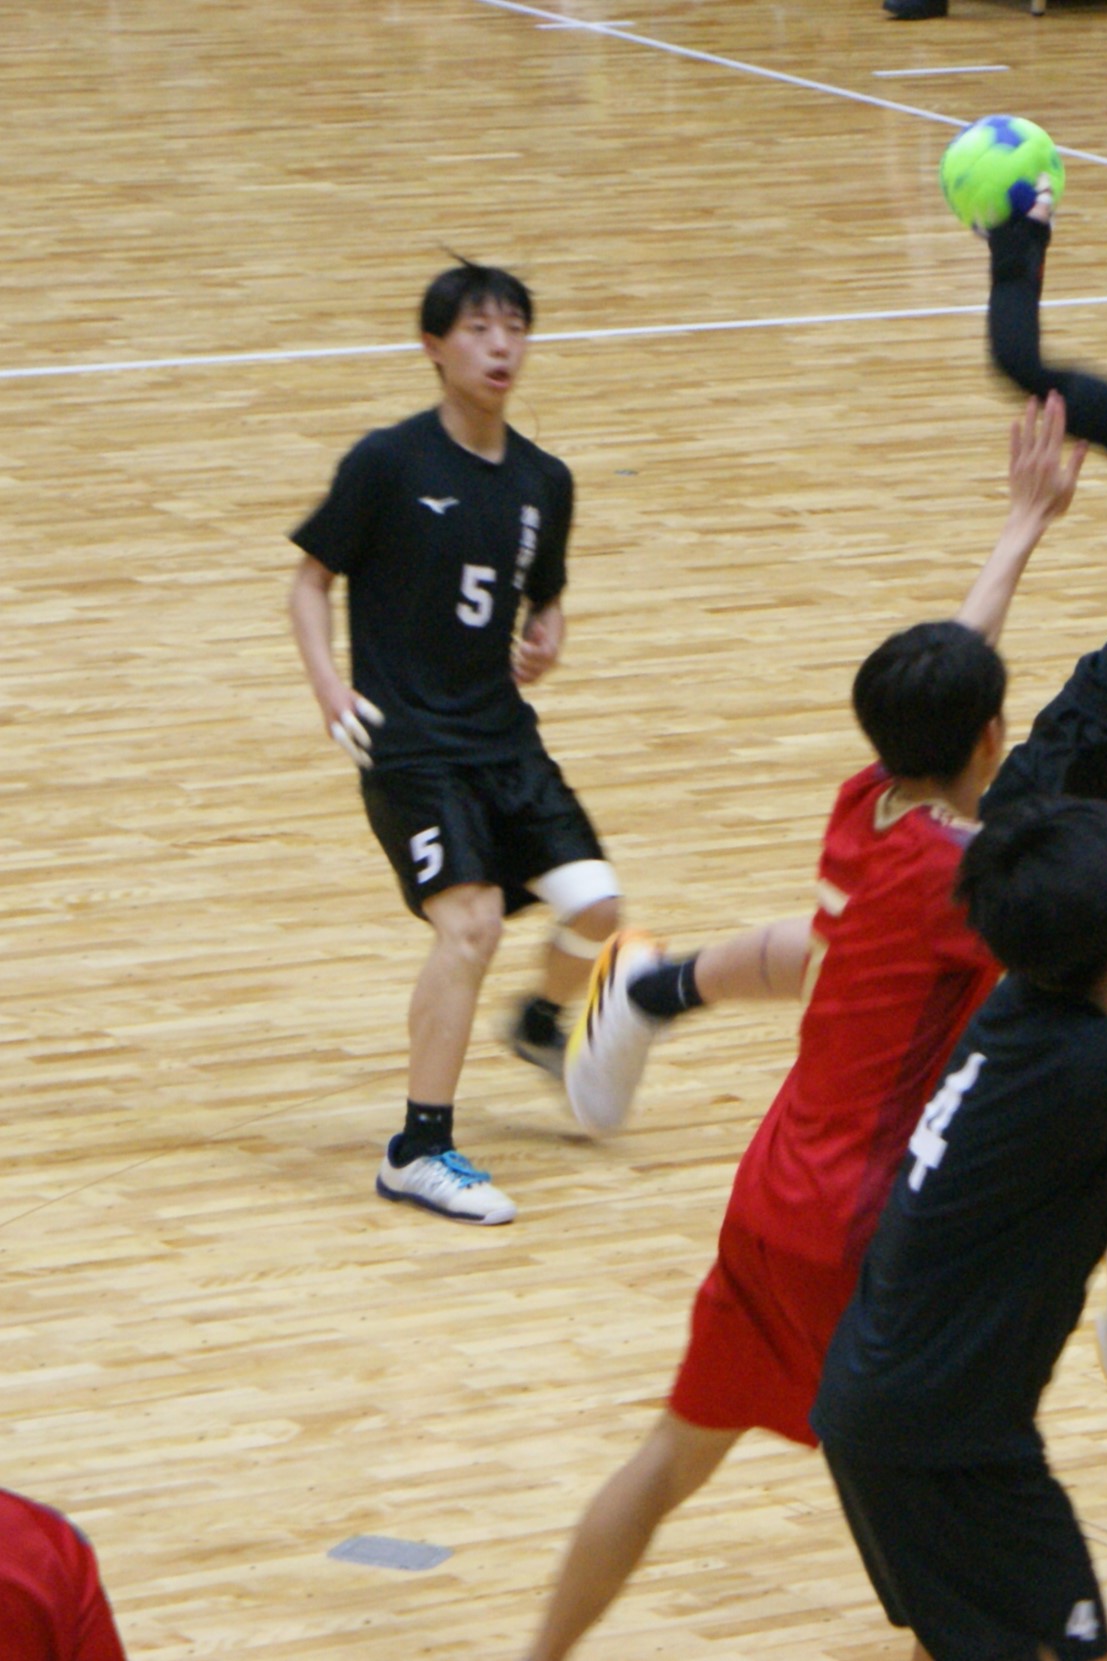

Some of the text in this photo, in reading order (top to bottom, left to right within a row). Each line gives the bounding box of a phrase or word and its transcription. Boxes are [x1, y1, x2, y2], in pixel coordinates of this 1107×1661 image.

[456, 563, 497, 628] 5
[409, 825, 444, 884] 5
[909, 1052, 987, 1192] 4
[1065, 1600, 1099, 1641] 4
